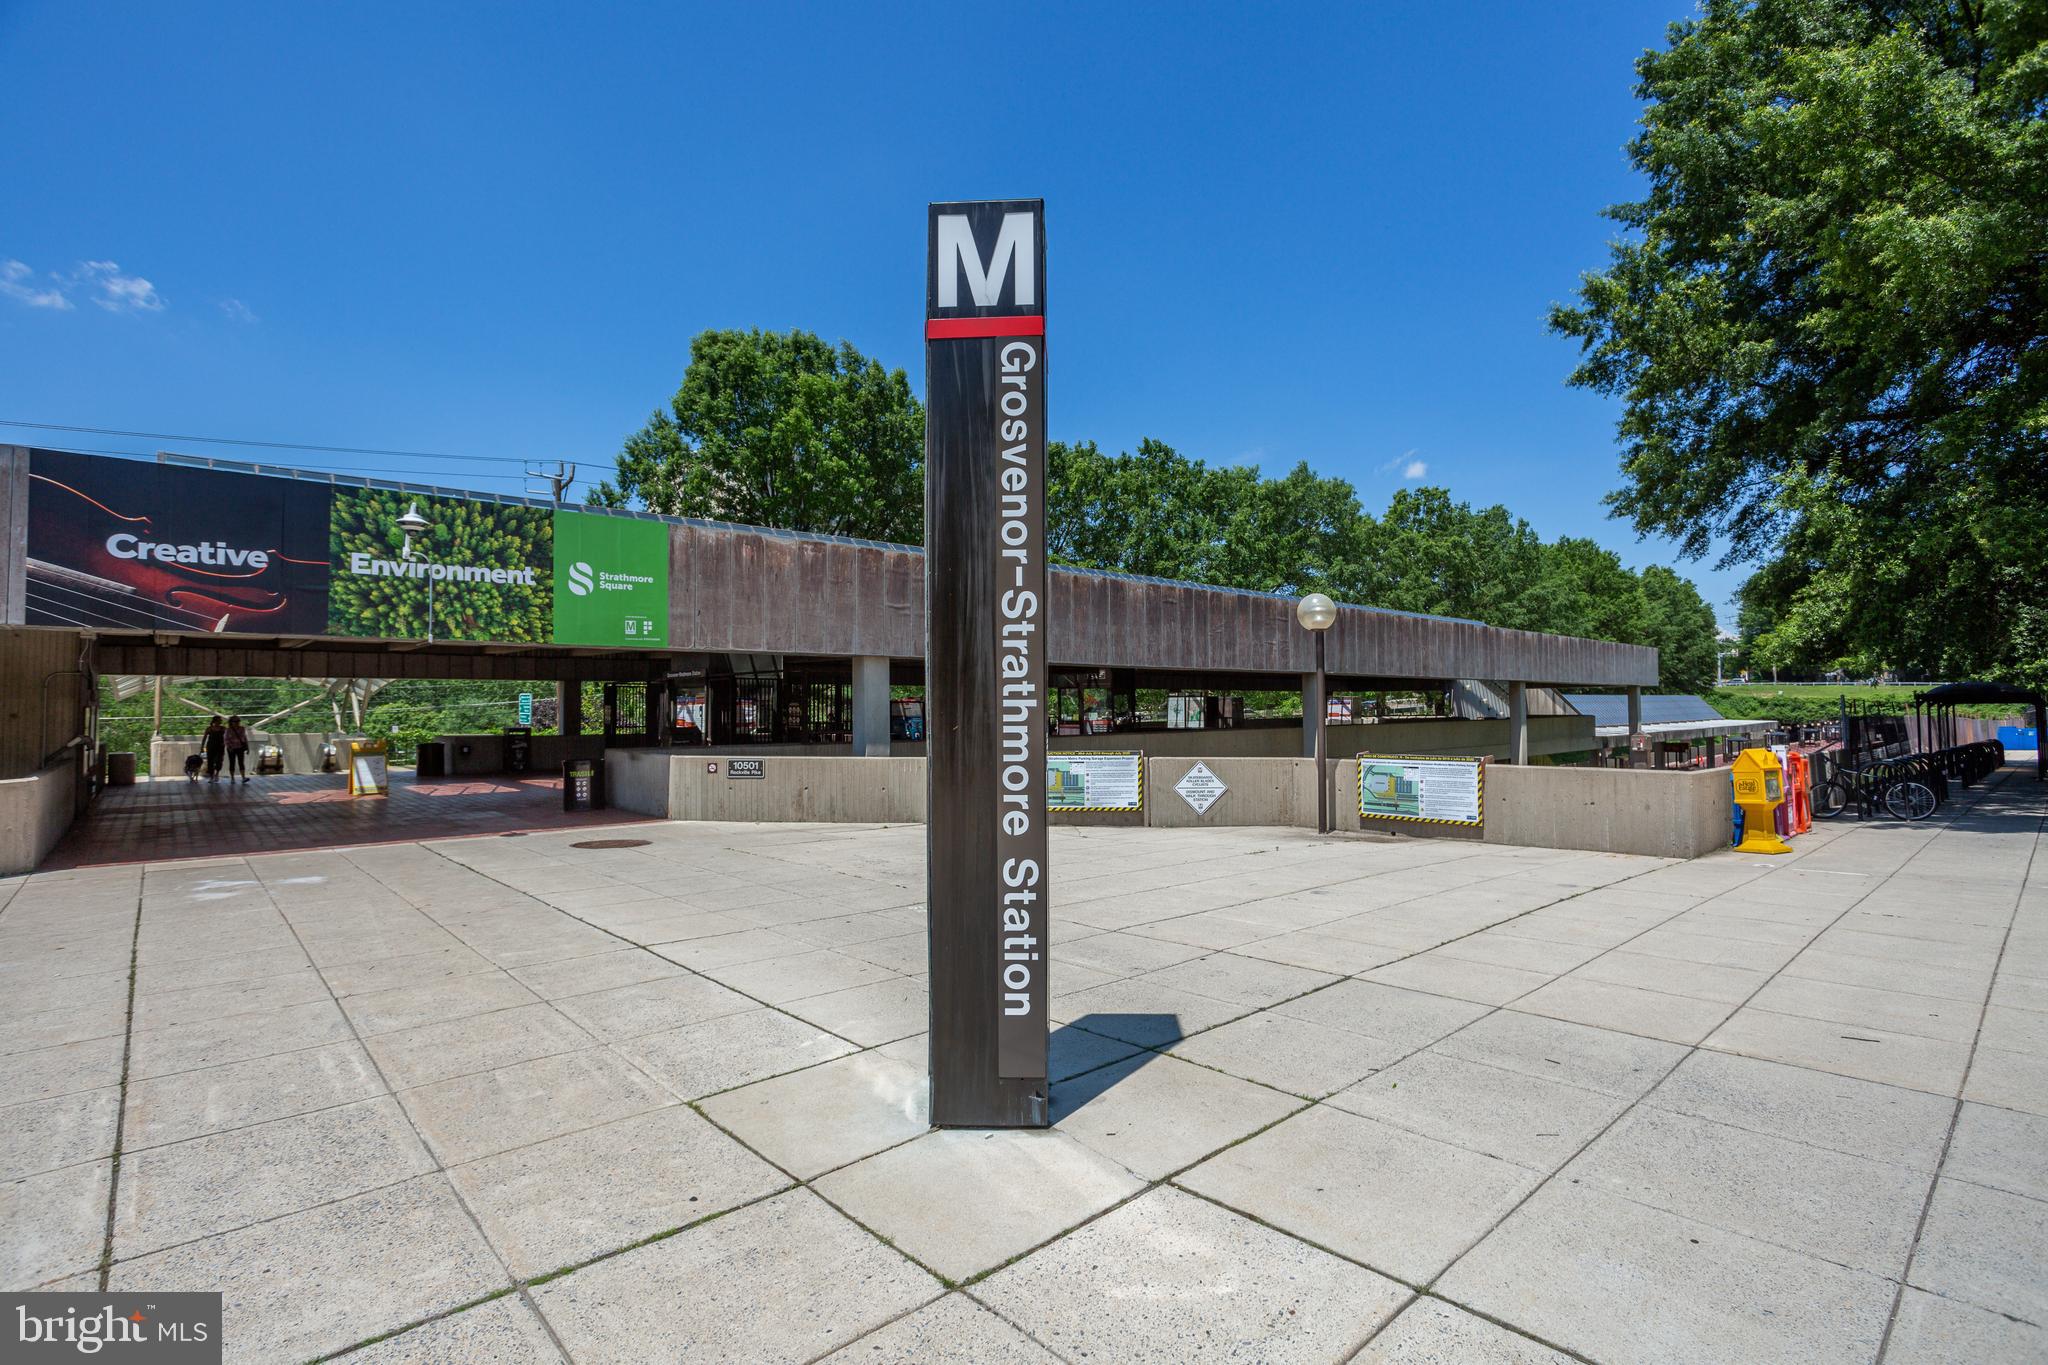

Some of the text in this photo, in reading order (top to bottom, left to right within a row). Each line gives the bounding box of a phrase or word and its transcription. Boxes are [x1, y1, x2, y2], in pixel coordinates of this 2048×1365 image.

[938, 212, 1034, 307] M
[106, 533, 269, 568] Creative
[350, 552, 536, 586] Environment
[600, 572, 654, 583] Strathmore
[600, 581, 633, 591] Square
[733, 761, 759, 770] 10501
[1002, 857, 1039, 1016] Station
